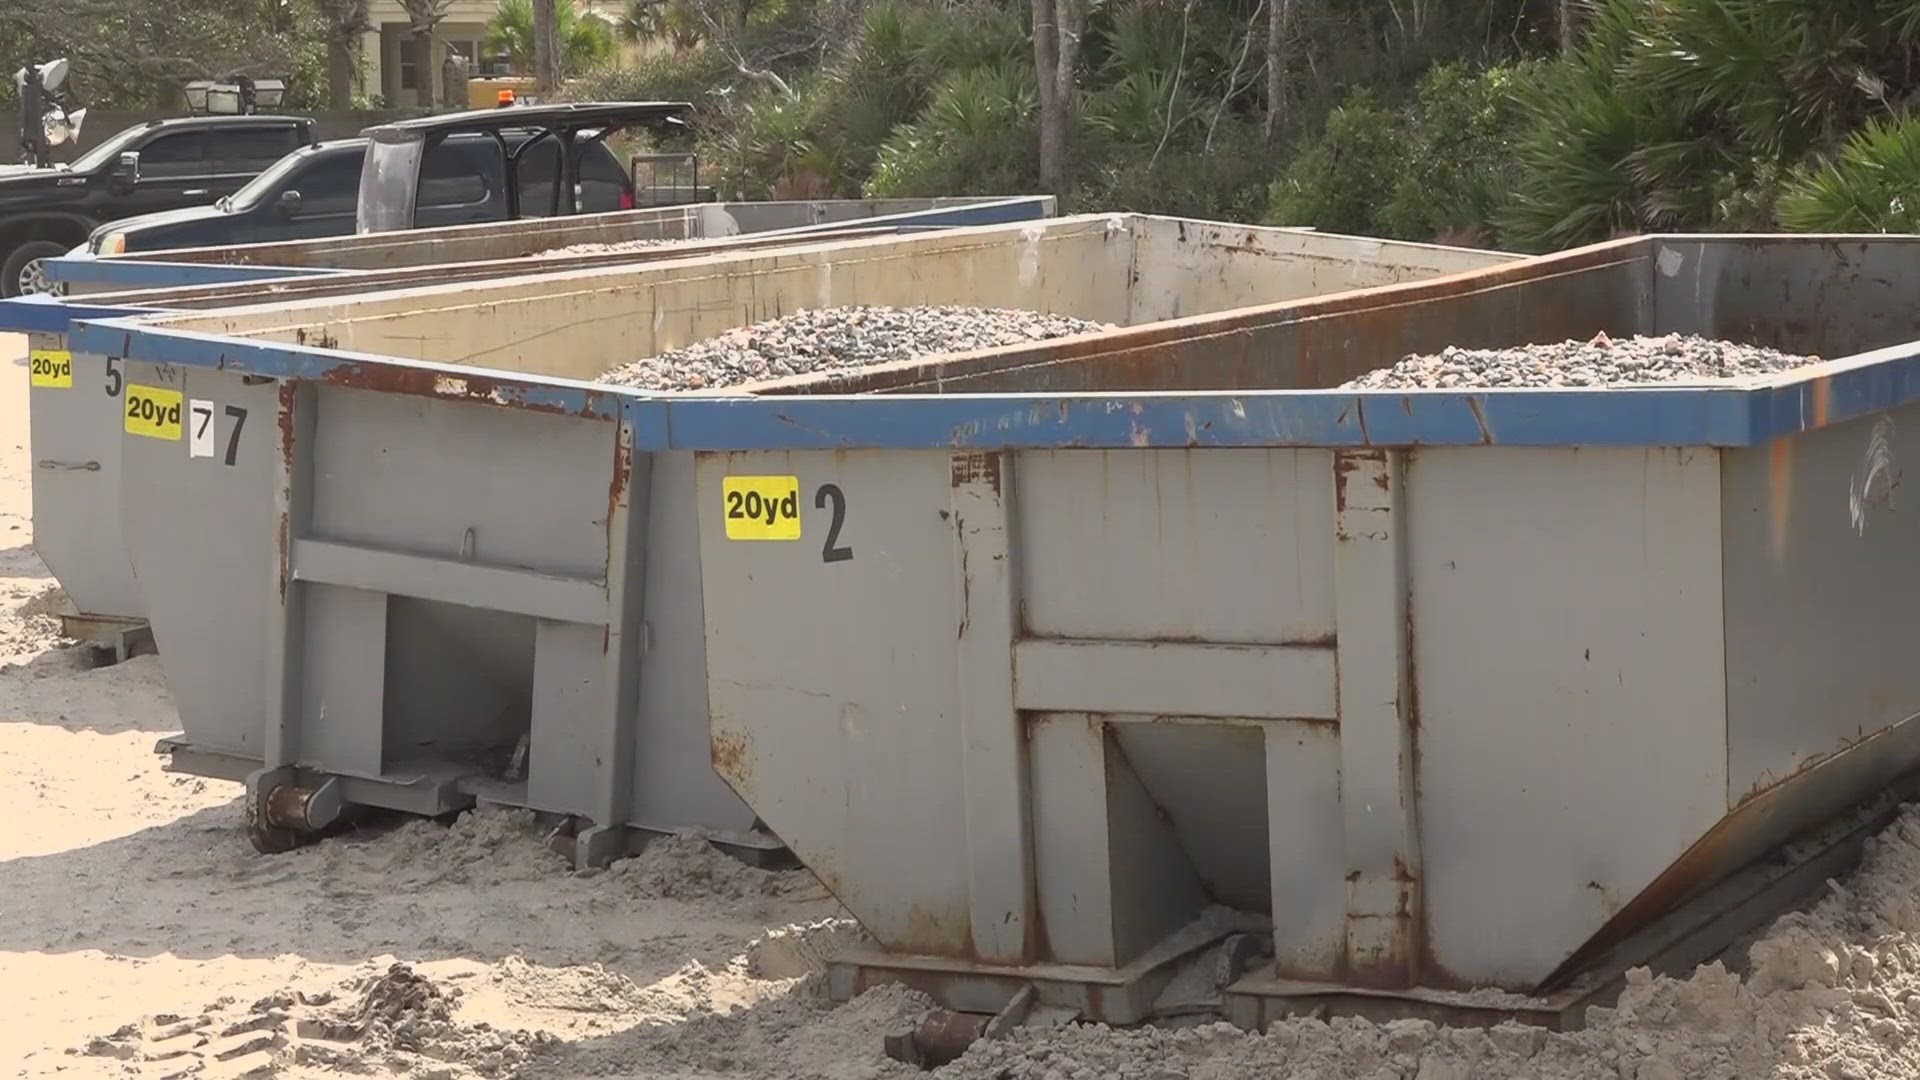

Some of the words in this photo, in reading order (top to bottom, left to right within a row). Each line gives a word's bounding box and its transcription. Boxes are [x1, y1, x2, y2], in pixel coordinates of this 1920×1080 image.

[32, 358, 71, 379] 20yd
[105, 356, 122, 397] 5
[127, 396, 181, 427] 20yd
[193, 407, 212, 440] 7
[225, 405, 248, 466] 7
[727, 490, 798, 525] 20yd
[815, 483, 854, 563] 2
